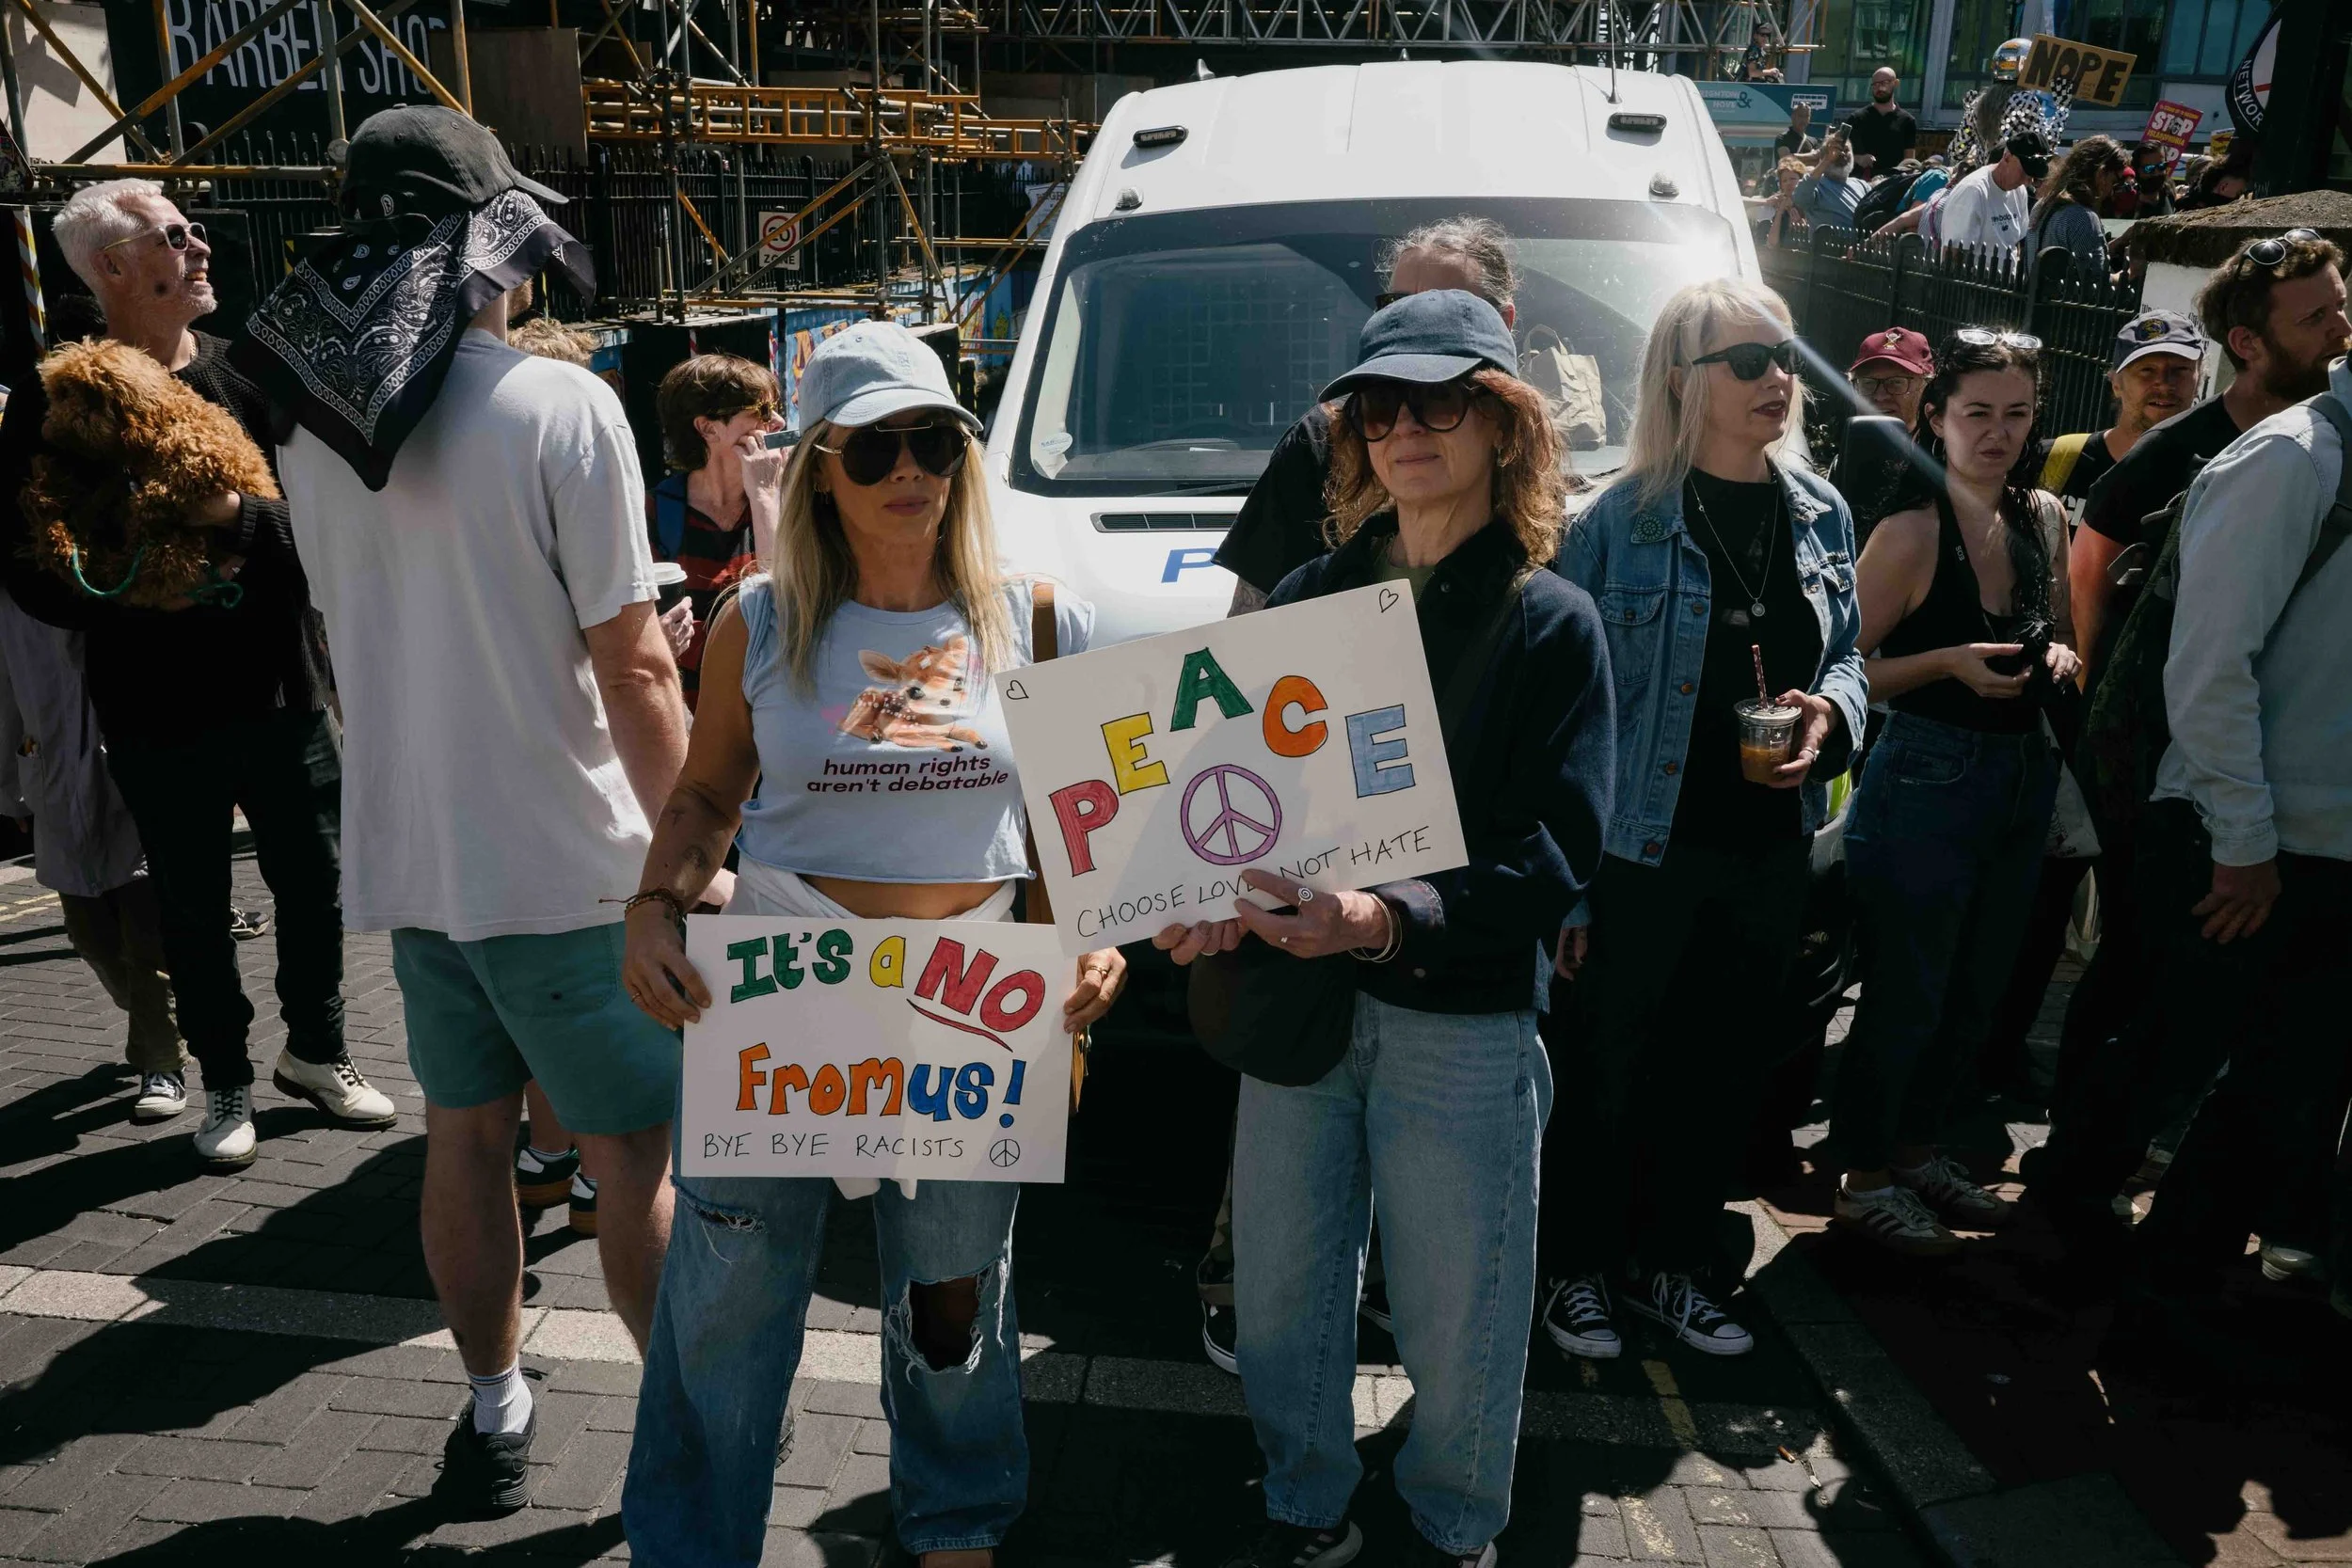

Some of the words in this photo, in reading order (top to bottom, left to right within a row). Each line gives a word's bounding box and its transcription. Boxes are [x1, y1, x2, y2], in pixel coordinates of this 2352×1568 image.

[354, 10, 446, 95] SHO
[2025, 40, 2128, 102] NOPE
[2152, 111, 2194, 137] STOP
[807, 778, 881, 792] aren't
[888, 769, 1009, 791] debatable
[823, 758, 911, 775] human
[918, 755, 991, 776] rights
[1048, 647, 1416, 877] PEACE
[1077, 884, 1185, 938] CHOOSE
[1279, 847, 1341, 879] NOT
[1351, 826, 1431, 865] HATE
[869, 935, 906, 989] a
[914, 936, 1046, 1033] NO
[704, 1132, 753, 1159] BYE
[771, 1132, 830, 1157] BYE
[856, 1133, 964, 1159] RACISTS
